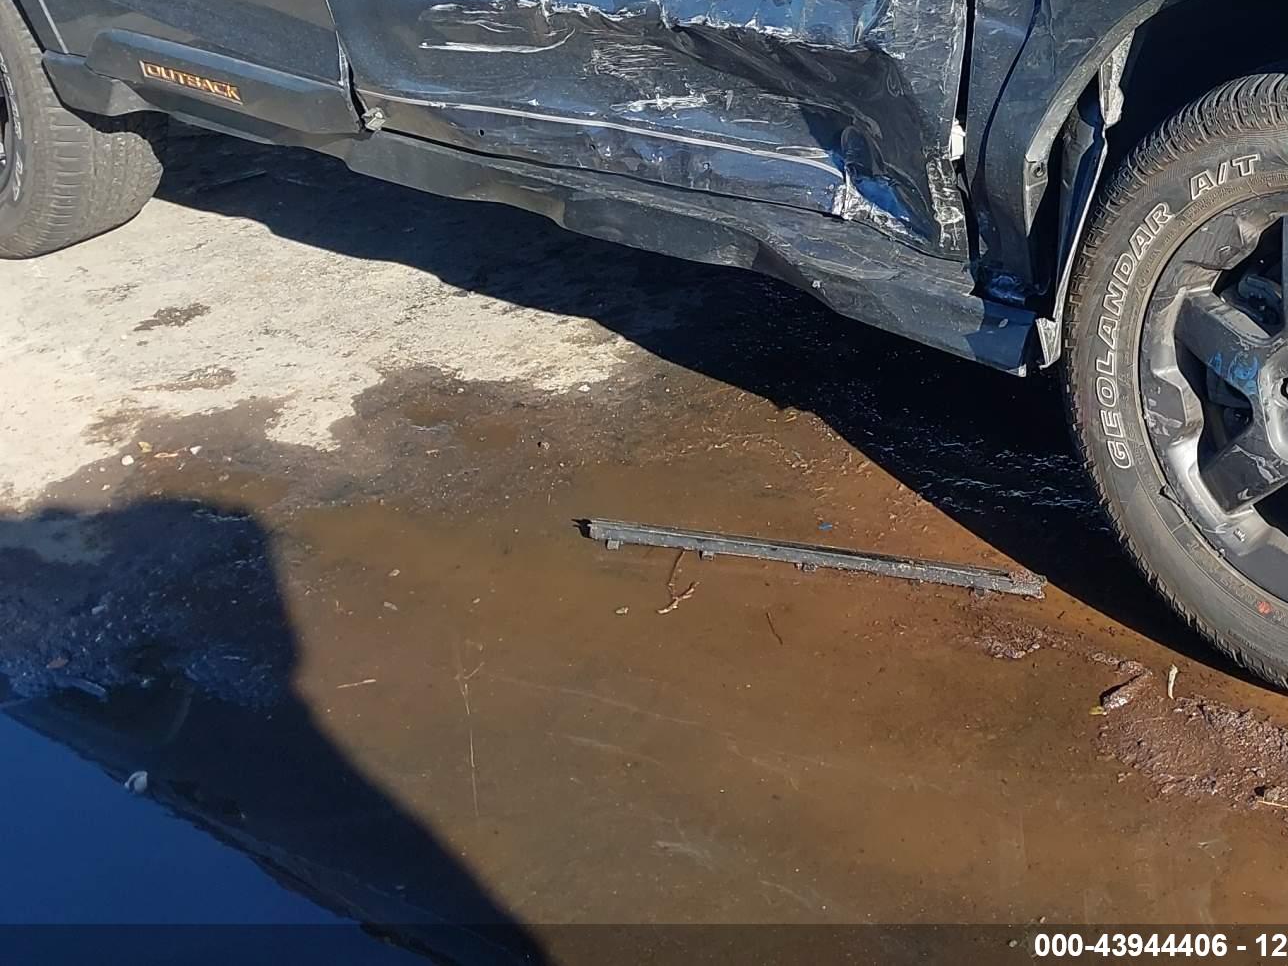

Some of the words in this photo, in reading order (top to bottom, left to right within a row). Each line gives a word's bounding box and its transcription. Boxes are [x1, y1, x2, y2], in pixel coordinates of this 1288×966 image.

[146, 63, 241, 102] OUTBACK
[1096, 202, 1175, 469] GEOLANDAR
[1190, 154, 1260, 201] A/T
